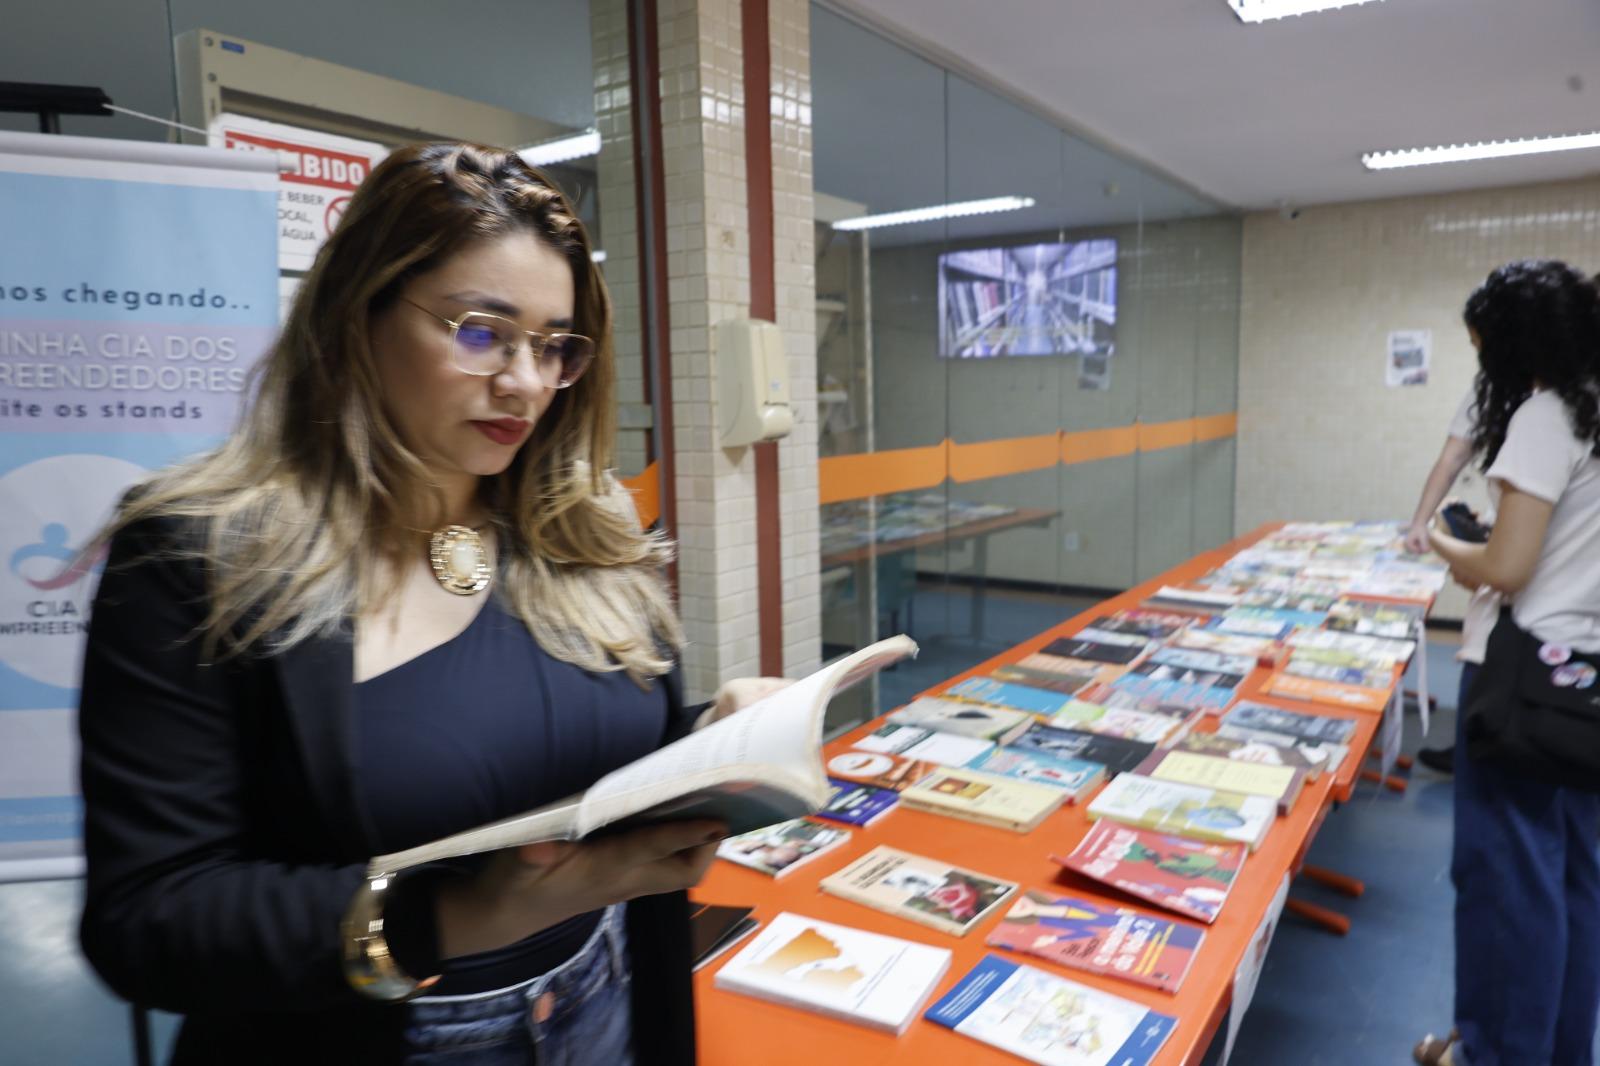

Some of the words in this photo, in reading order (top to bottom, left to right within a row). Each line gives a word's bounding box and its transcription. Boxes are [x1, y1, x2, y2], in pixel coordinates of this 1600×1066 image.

[99, 332, 155, 360] CIA
[164, 334, 238, 362] DOS
[54, 403, 88, 418] os
[100, 399, 202, 420] stands
[25, 599, 80, 618] CIA
